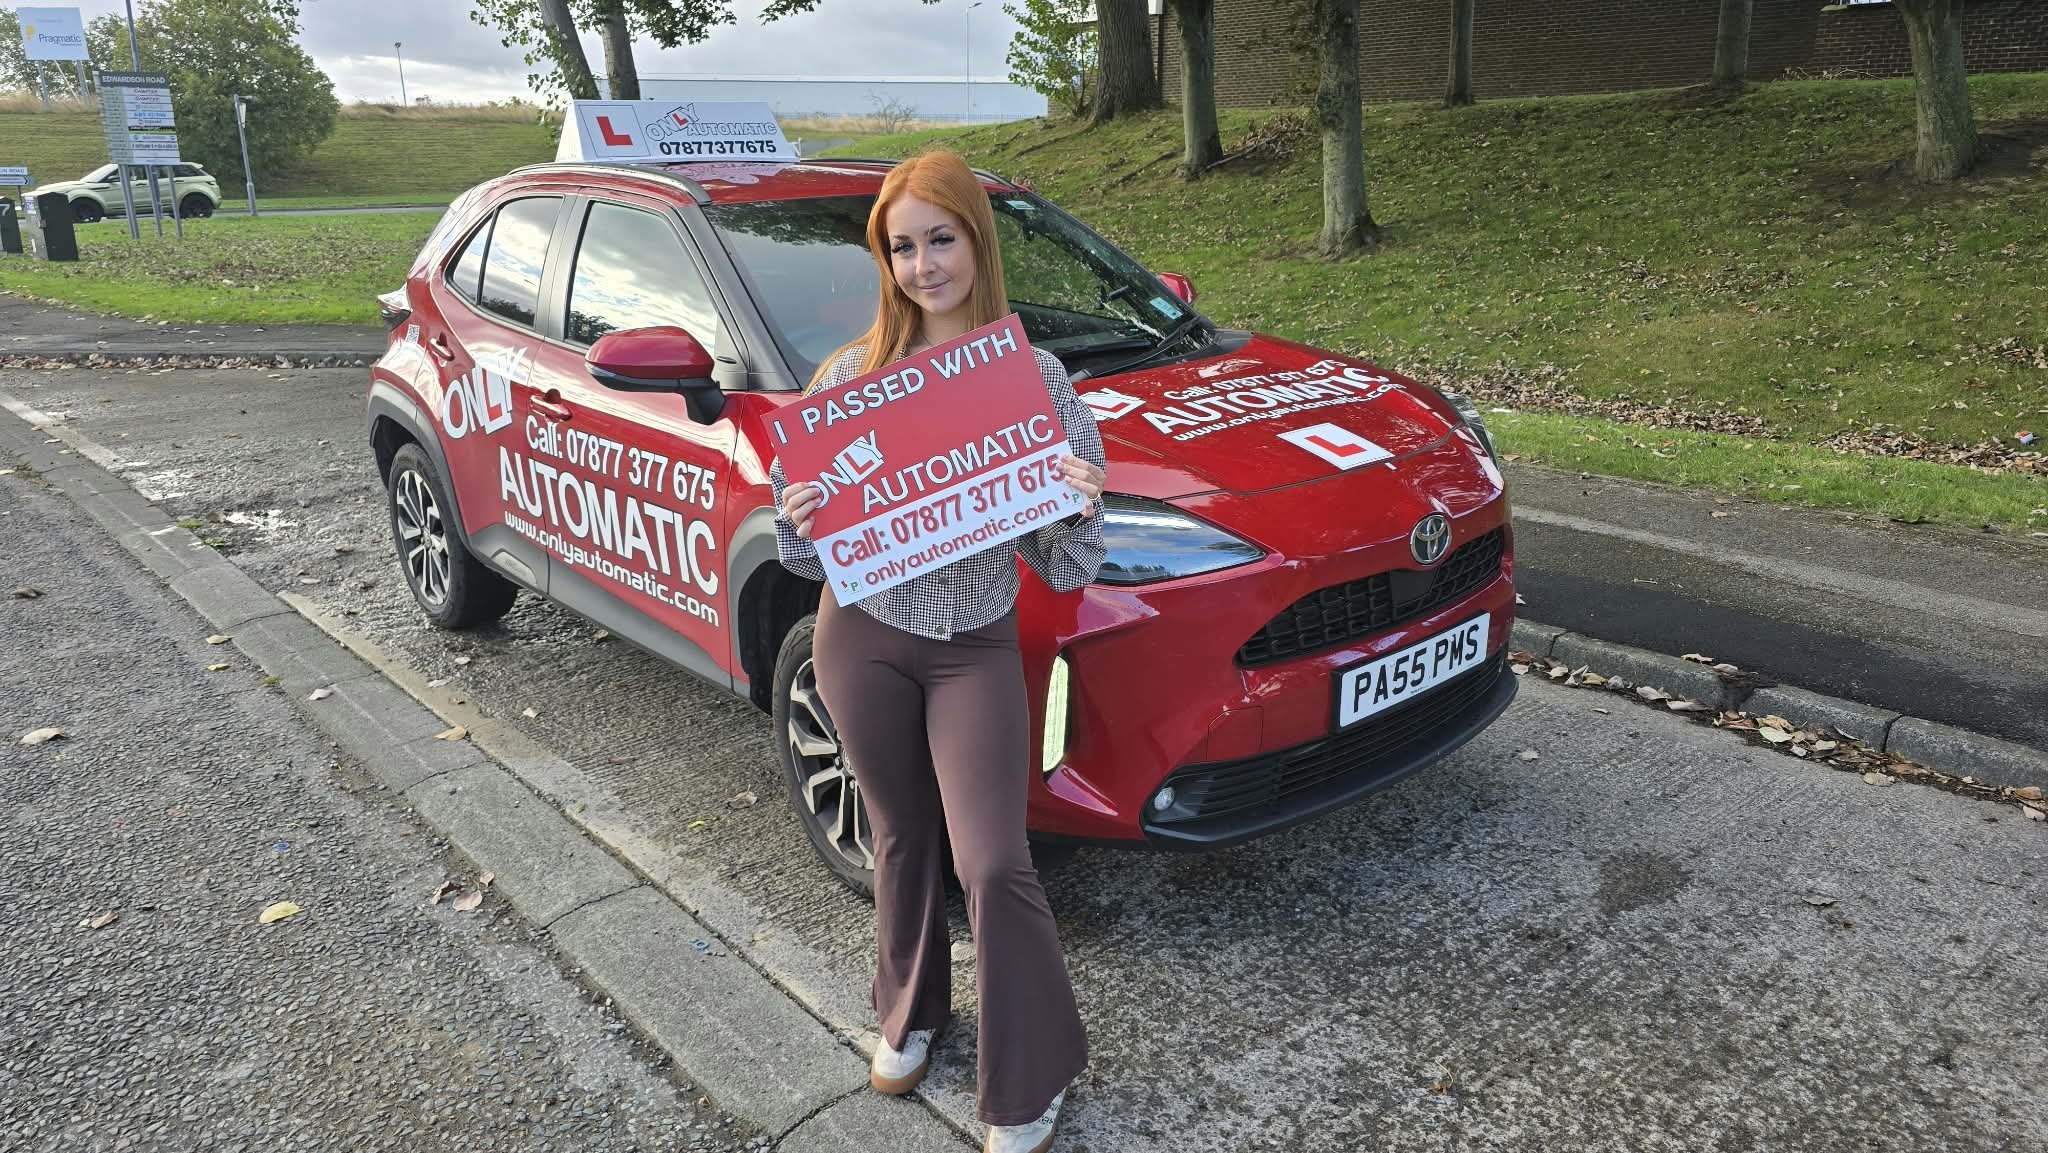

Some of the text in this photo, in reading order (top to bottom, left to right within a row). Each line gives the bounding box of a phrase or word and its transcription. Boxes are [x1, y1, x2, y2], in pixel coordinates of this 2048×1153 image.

[38, 33, 82, 44] Pragmatic
[596, 116, 633, 146] L
[645, 103, 700, 142] ONLY
[660, 140, 777, 155] 07877377675
[686, 122, 777, 136] AUTOMATIC
[773, 328, 1017, 445] I PASSED WITH
[1078, 387, 1147, 421] LY
[1142, 367, 1390, 435] AUTOMATIC
[1163, 385, 1217, 401] Call:
[1270, 371, 1311, 384] 377
[1305, 359, 1348, 376] 675
[1173, 383, 1408, 442] www.onlyautomatic.com
[525, 414, 716, 511] Call: 07877 377 675
[862, 413, 1054, 514] AUTOMATIC
[1304, 434, 1368, 458] L
[500, 445, 719, 596] AUTOMATIC
[831, 453, 1066, 568] Call: 07877 377 675
[864, 498, 1060, 586] onlyautomatic.com
[504, 510, 720, 629] www.onlyautomatic.com
[1353, 623, 1480, 714] PA55 PMS
